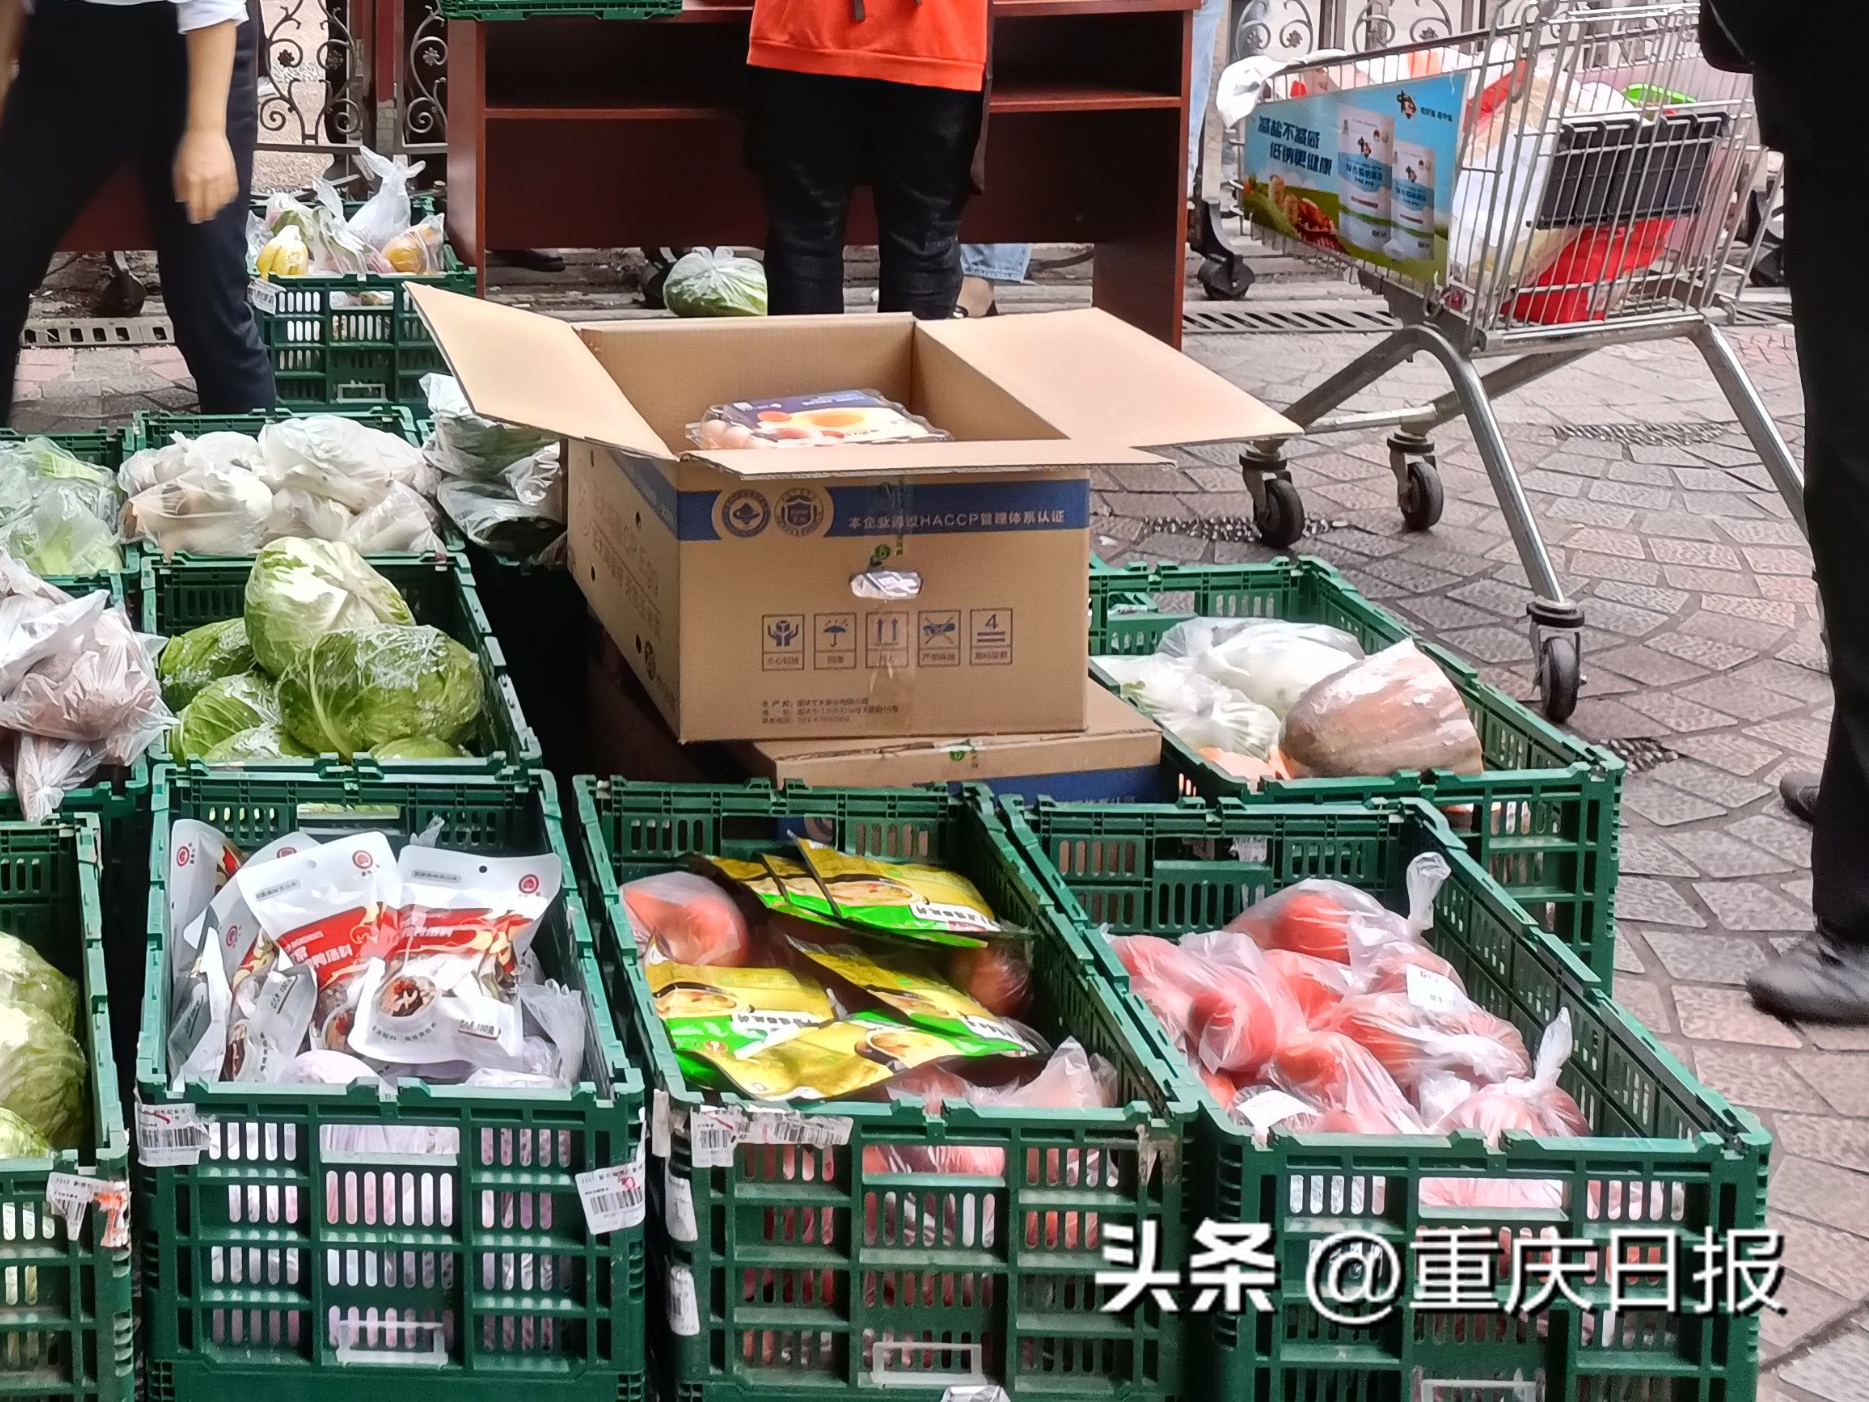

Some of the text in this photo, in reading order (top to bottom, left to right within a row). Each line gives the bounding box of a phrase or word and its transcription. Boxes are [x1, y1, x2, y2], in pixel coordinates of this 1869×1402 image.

[1269, 141, 1333, 176] 低钠更健康
[984, 613, 999, 630] 4
